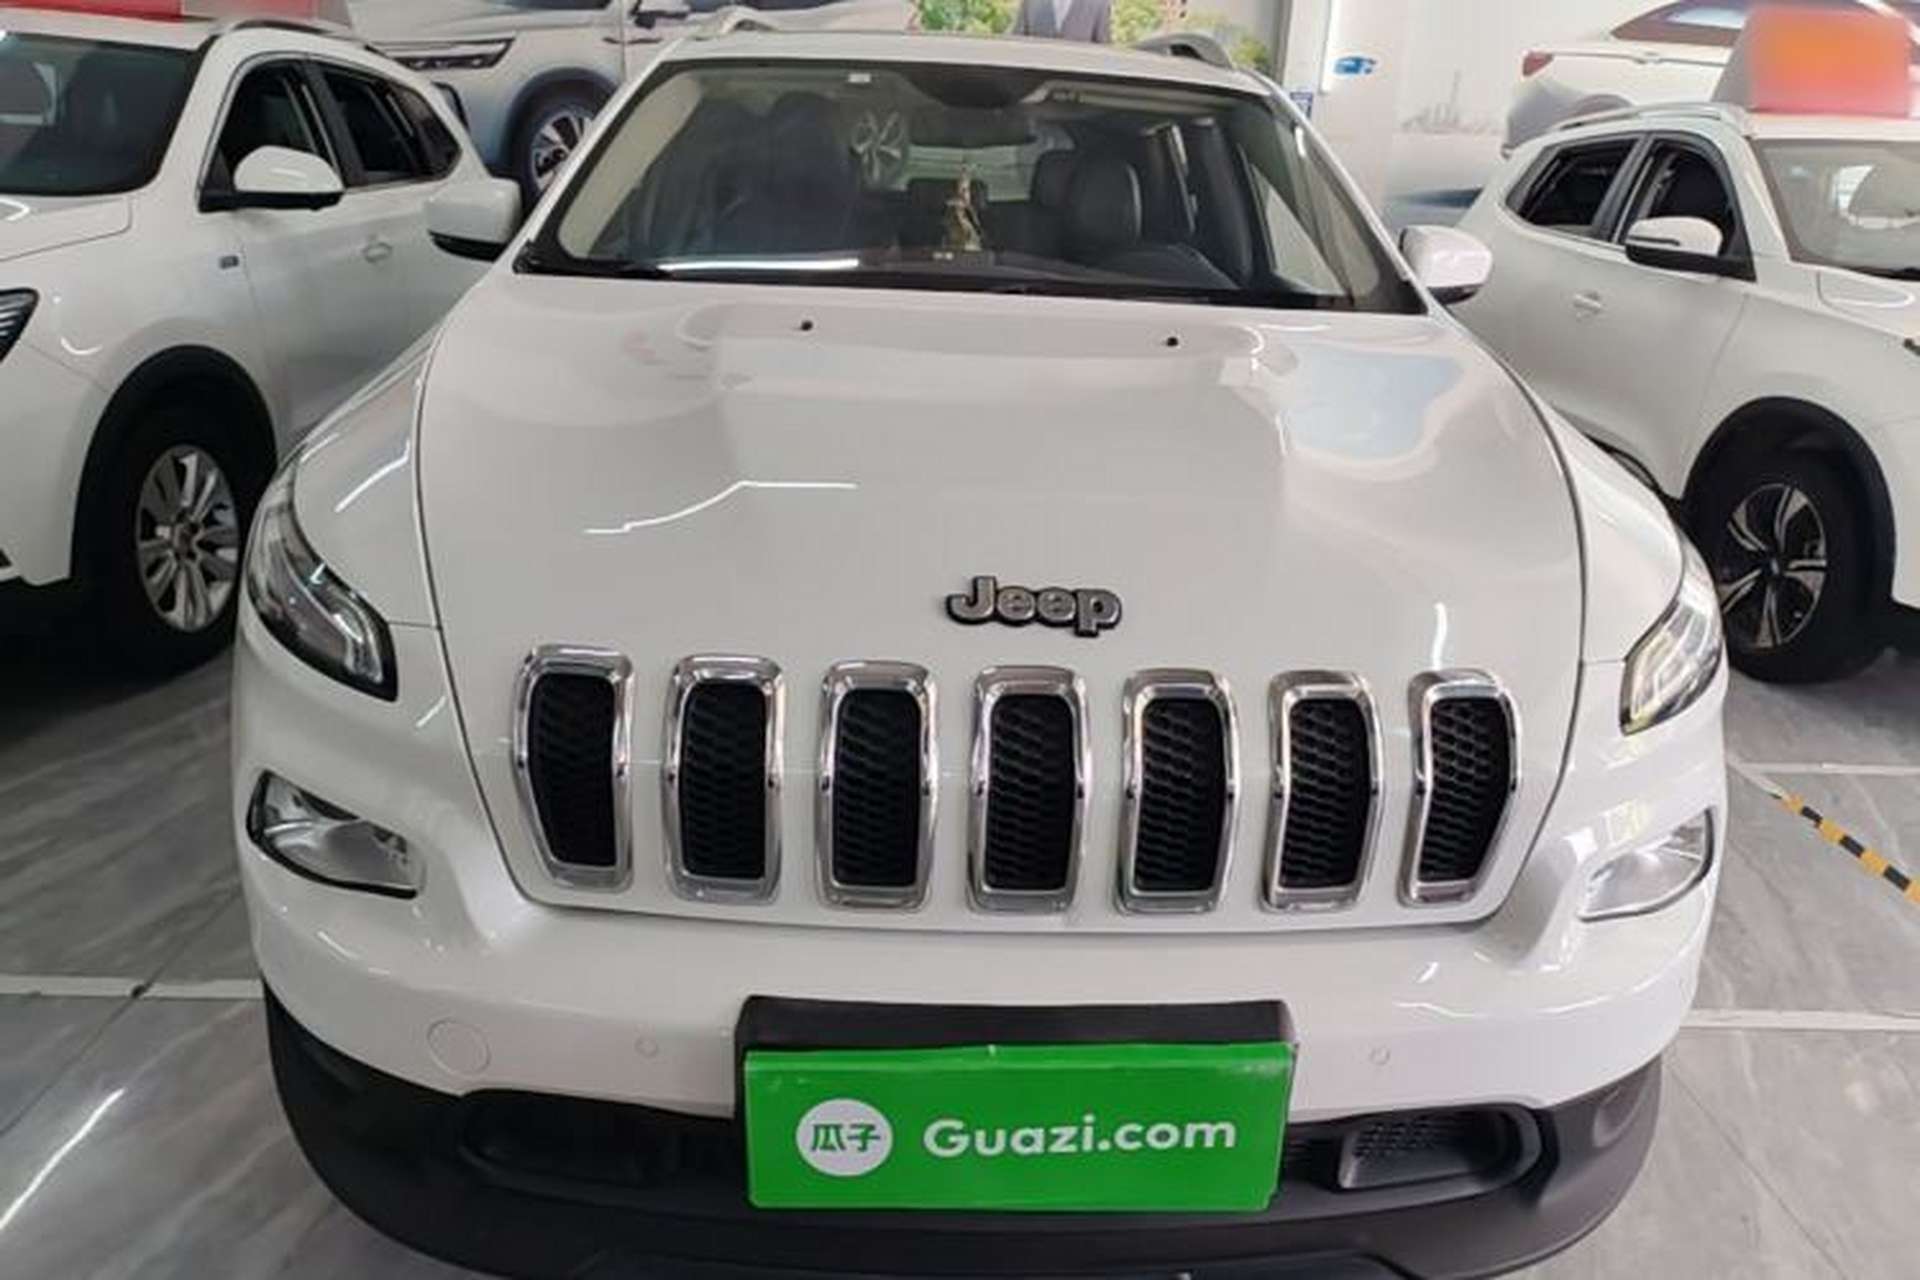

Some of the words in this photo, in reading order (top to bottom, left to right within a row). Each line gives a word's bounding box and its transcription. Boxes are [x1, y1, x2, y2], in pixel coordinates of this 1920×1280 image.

[945, 575, 1122, 638] Jeep
[811, 1121, 881, 1153] 瓜子
[922, 1114, 1237, 1158] Guazi.com
